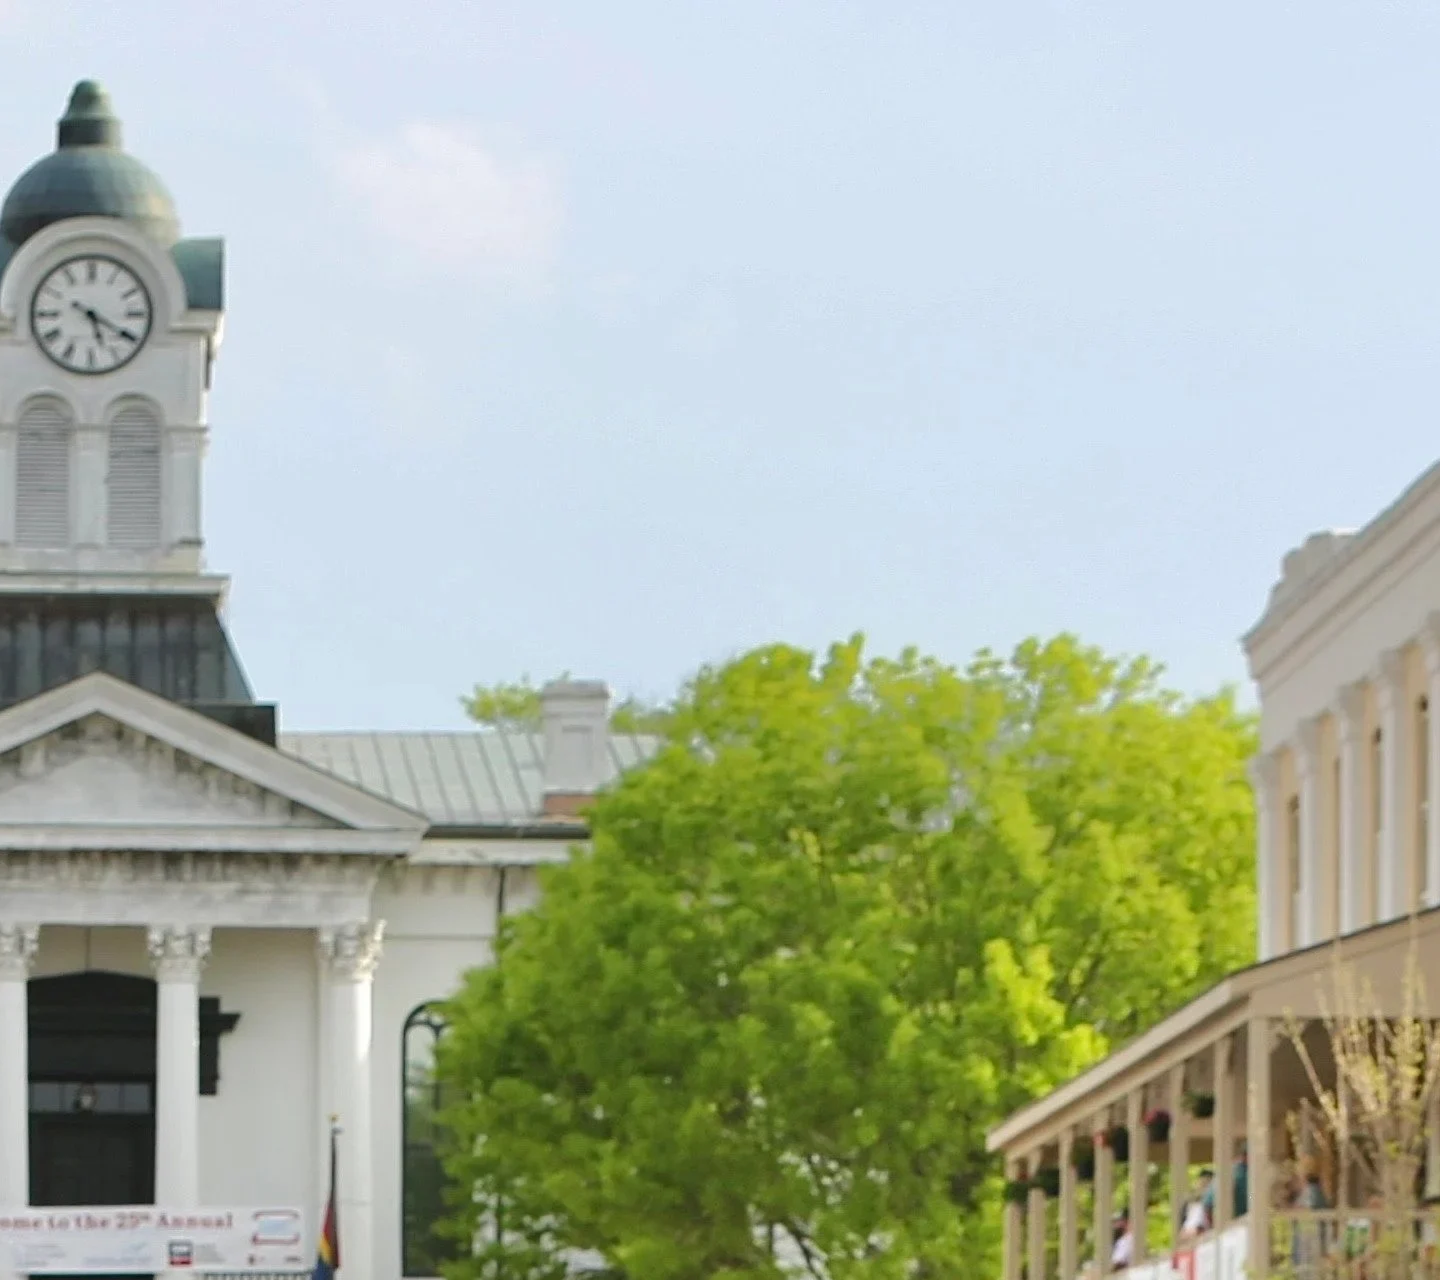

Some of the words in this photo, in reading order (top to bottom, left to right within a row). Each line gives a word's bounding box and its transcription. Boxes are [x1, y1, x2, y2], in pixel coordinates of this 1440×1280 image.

[49, 1212, 72, 1230] to
[76, 1211, 110, 1229] the
[157, 1211, 234, 1229] Annual
